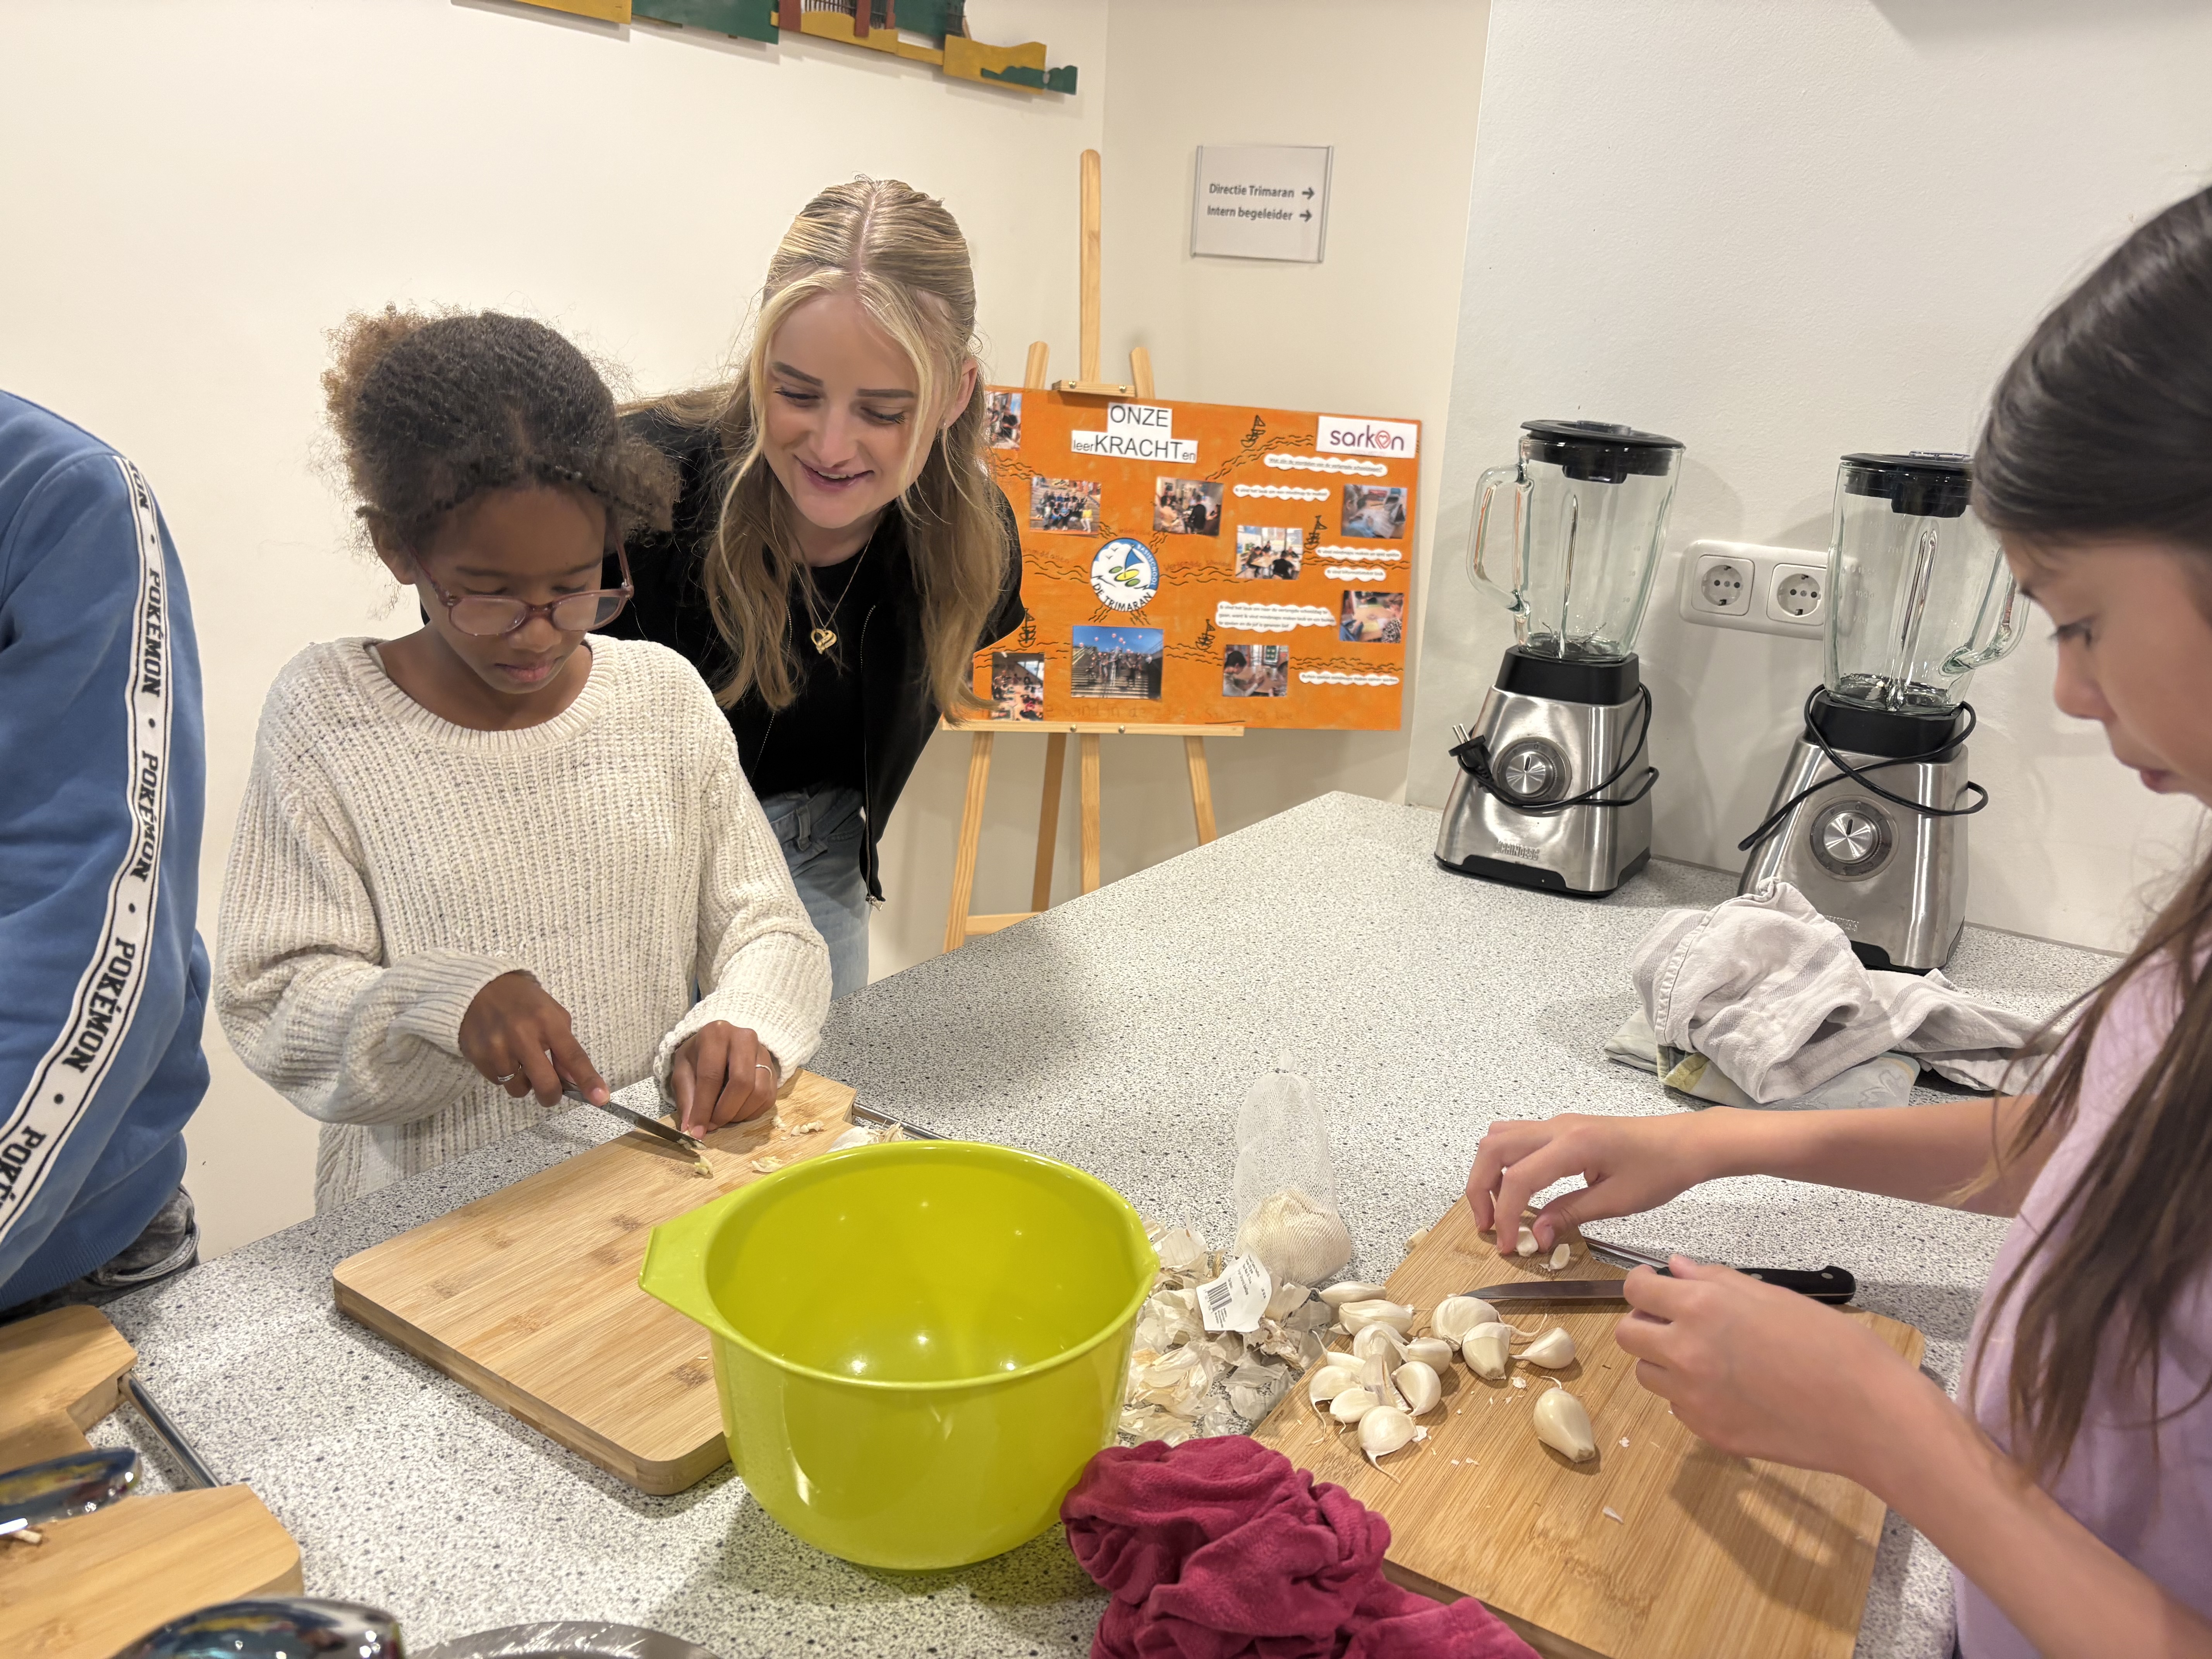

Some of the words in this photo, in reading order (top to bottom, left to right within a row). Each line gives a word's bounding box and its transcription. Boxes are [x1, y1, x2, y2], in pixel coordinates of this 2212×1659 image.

[1209, 183, 1247, 195] Directie
[1249, 185, 1294, 198] Trimaran
[1207, 205, 1236, 217] Intern
[1238, 206, 1293, 220] begeleider
[1110, 405, 1169, 427] ONZE
[1092, 583, 1104, 597] DE
[1104, 592, 1152, 611] TRIMARAN
[142, 568, 163, 697] POKÉMON
[130, 750, 158, 882] POKÉMON
[62, 937, 135, 1073] POKÉMON
